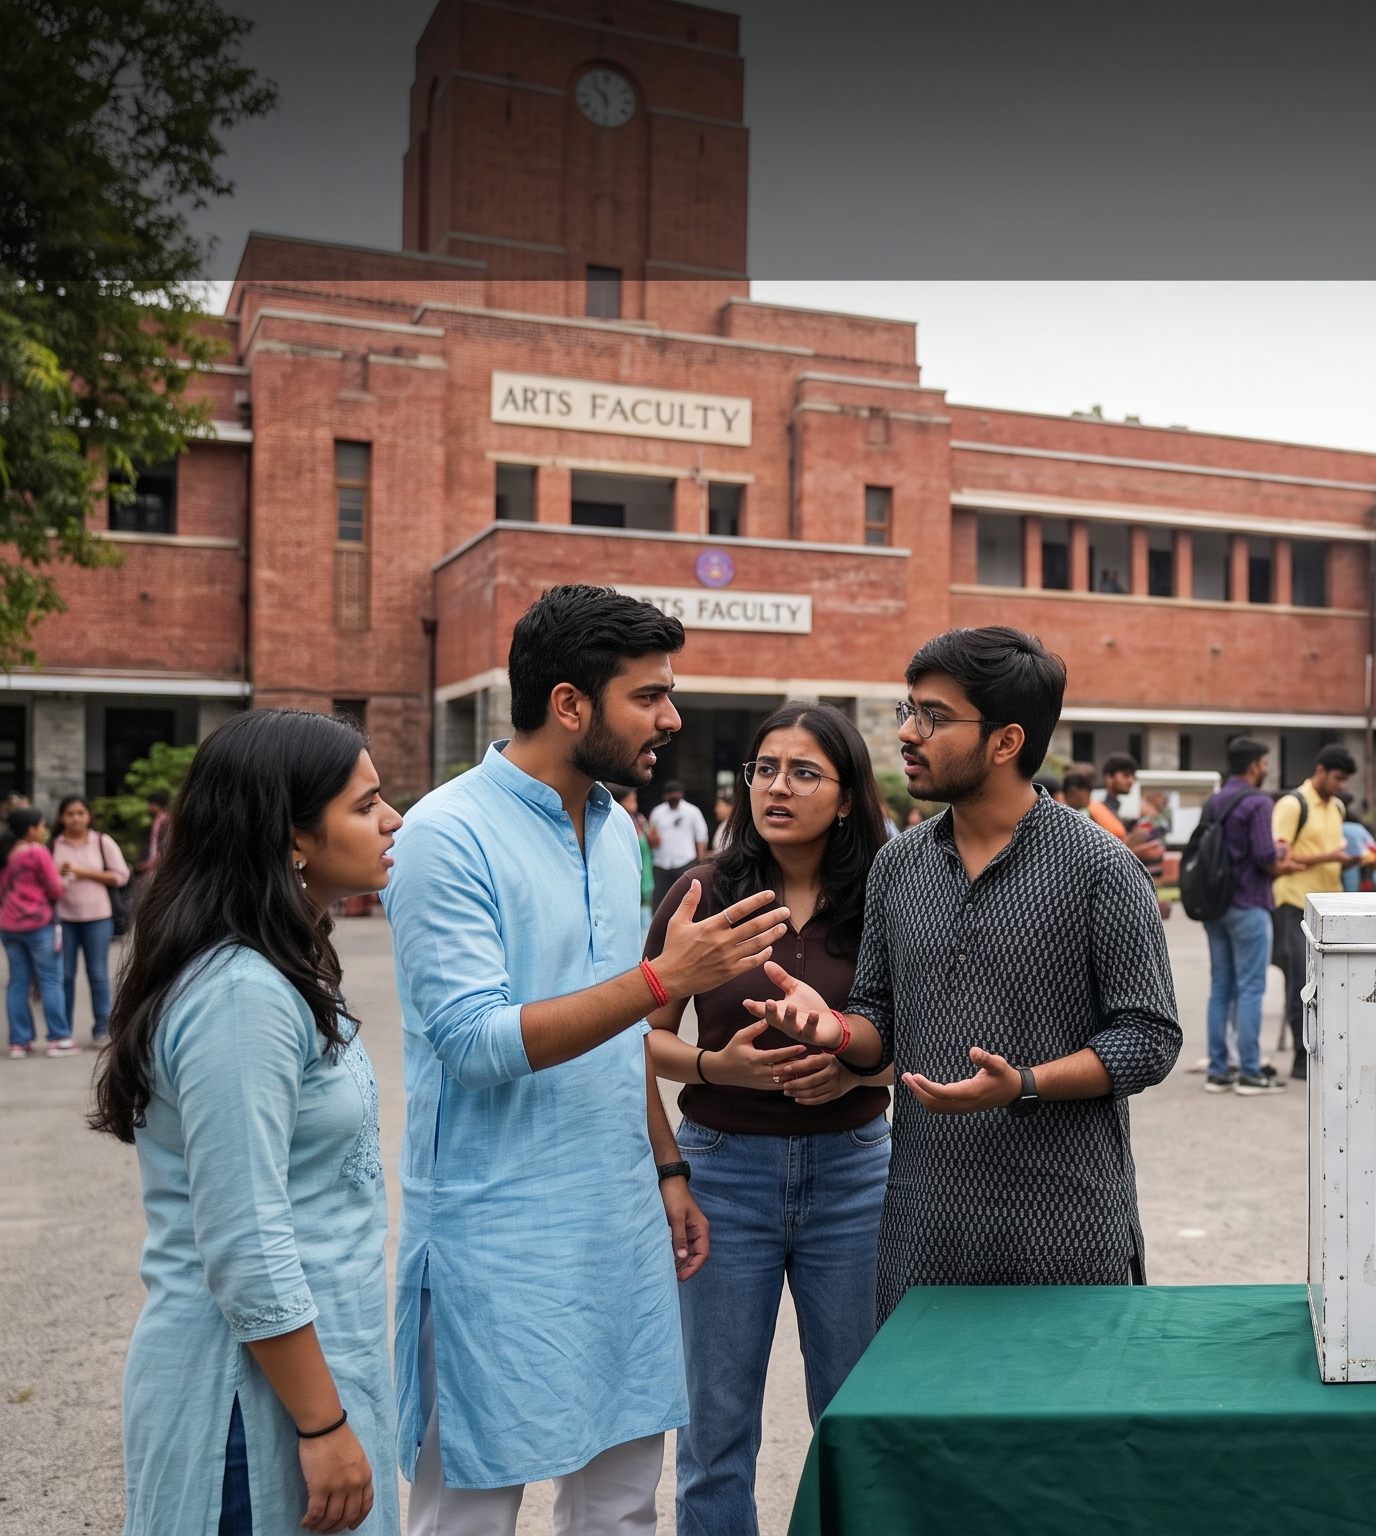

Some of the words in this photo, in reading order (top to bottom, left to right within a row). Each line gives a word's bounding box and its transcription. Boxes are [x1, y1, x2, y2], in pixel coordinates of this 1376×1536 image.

[501, 385, 572, 417] ARTS
[590, 394, 740, 432] FACULTY
[697, 598, 801, 624] FACULTY
